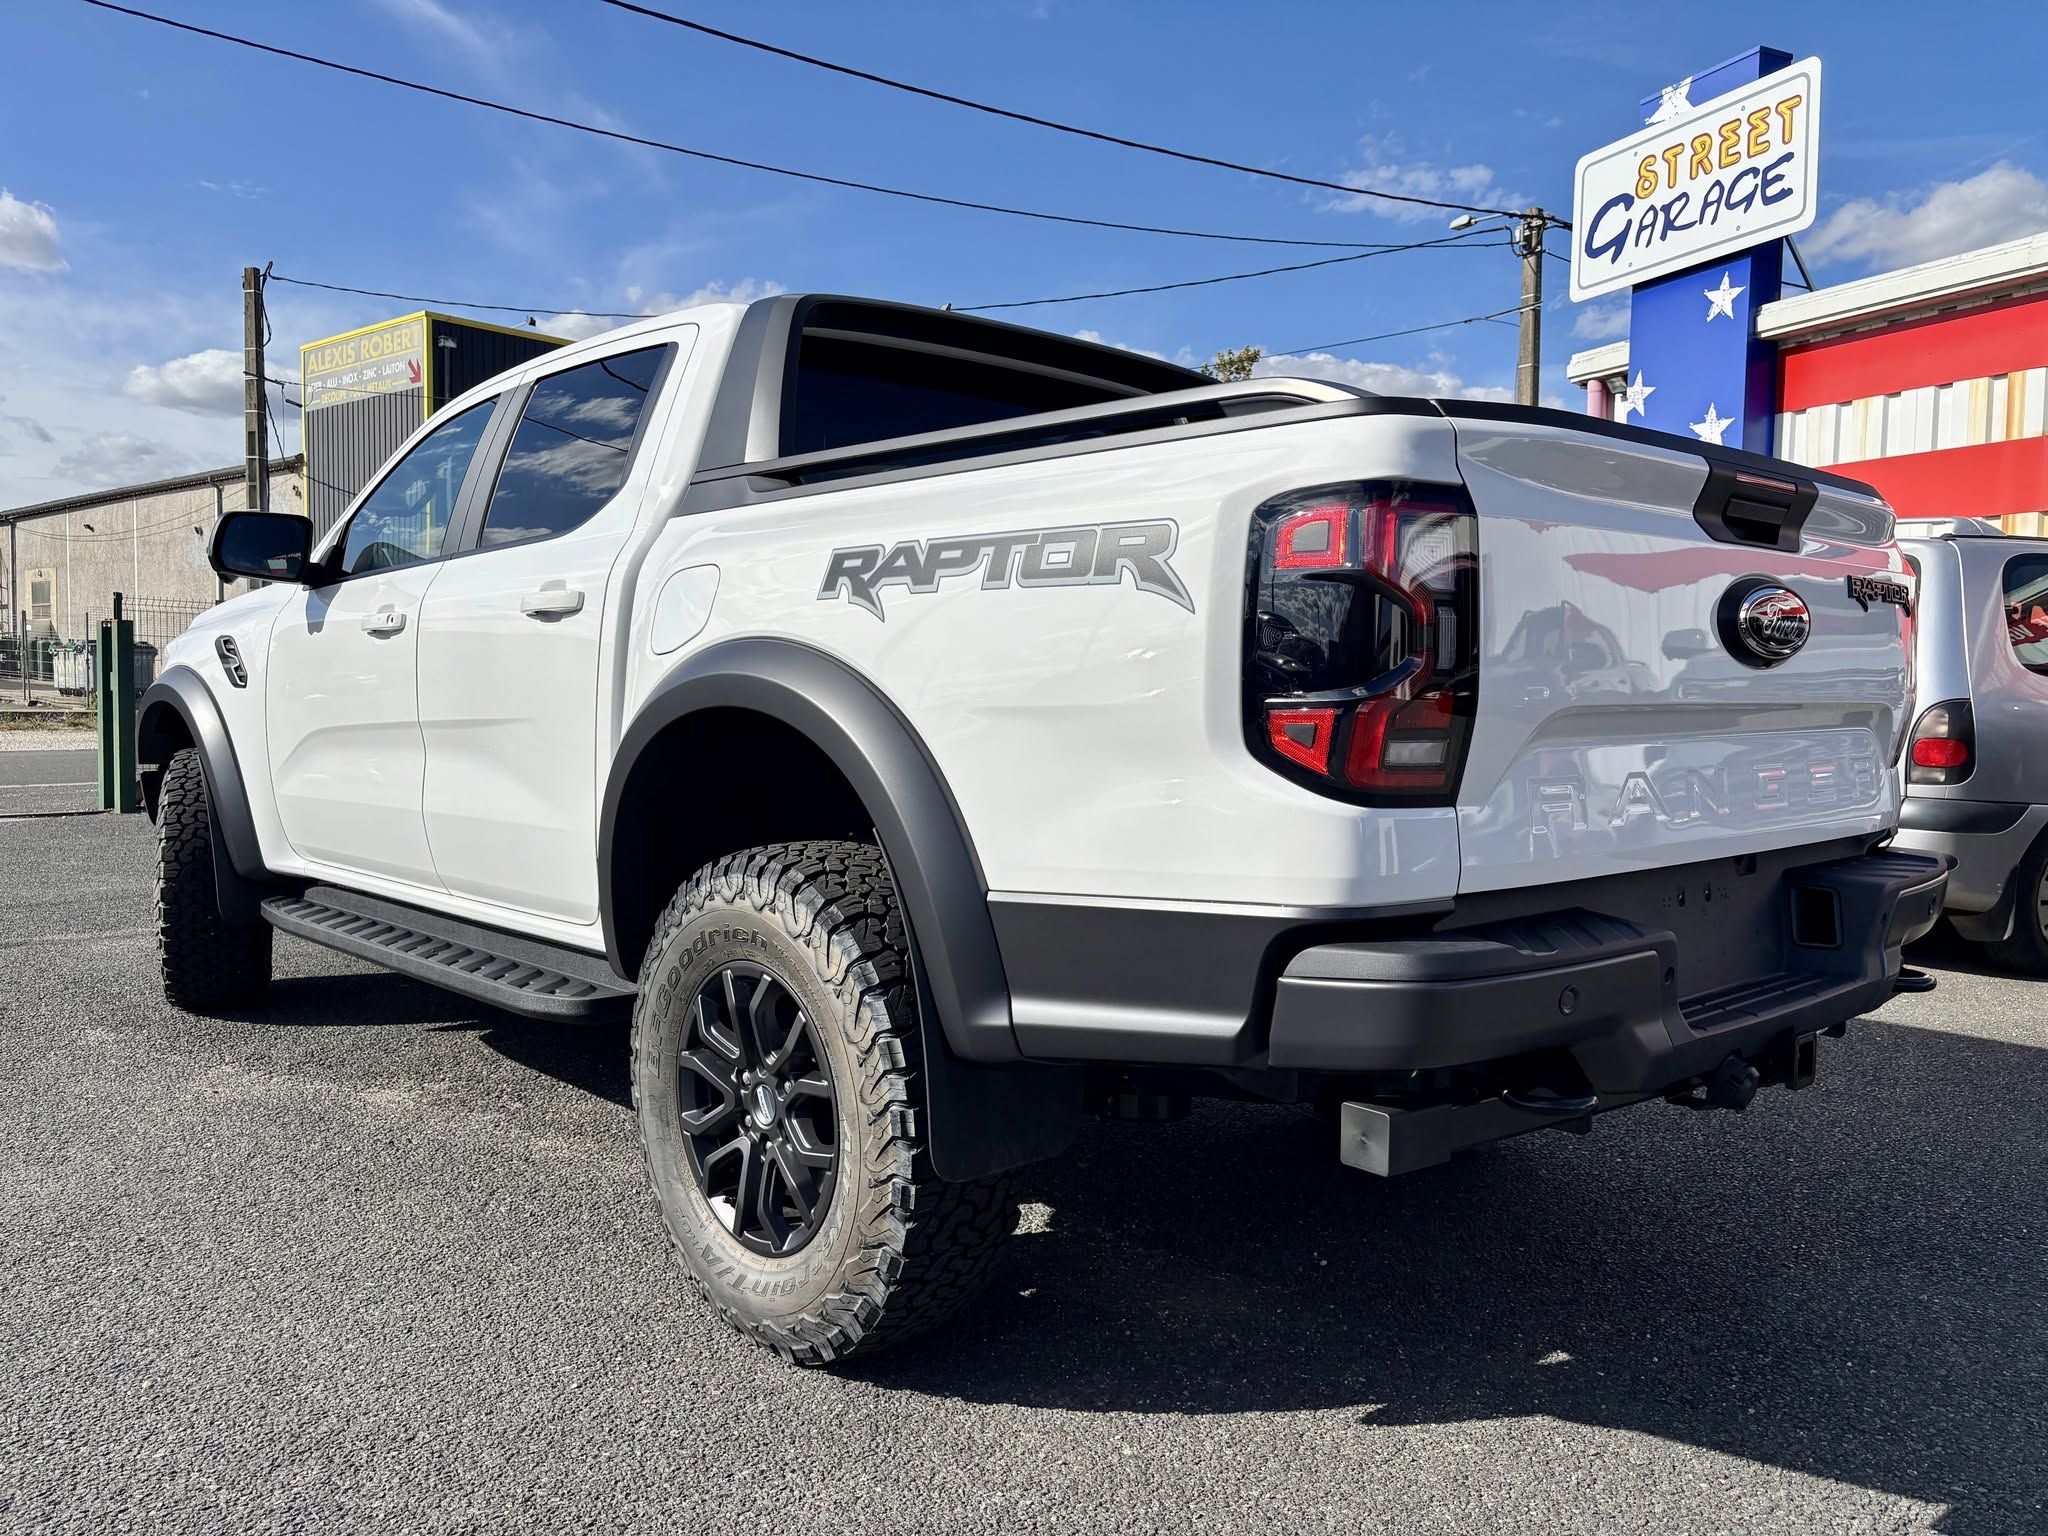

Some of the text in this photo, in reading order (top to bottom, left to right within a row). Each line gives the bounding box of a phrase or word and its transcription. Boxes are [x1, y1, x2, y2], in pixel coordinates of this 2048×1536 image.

[1635, 95, 1802, 199] STREET
[1585, 152, 1795, 264] GARAGE
[307, 326, 419, 374] ALEXIS ROBERT
[342, 371, 358, 384] INOX
[363, 367, 376, 380] ZINC
[383, 360, 405, 375] LAITON
[816, 518, 1195, 623] RAPTOR
[1763, 602, 1800, 638] Ford
[1847, 575, 1911, 618] RAPTOR
